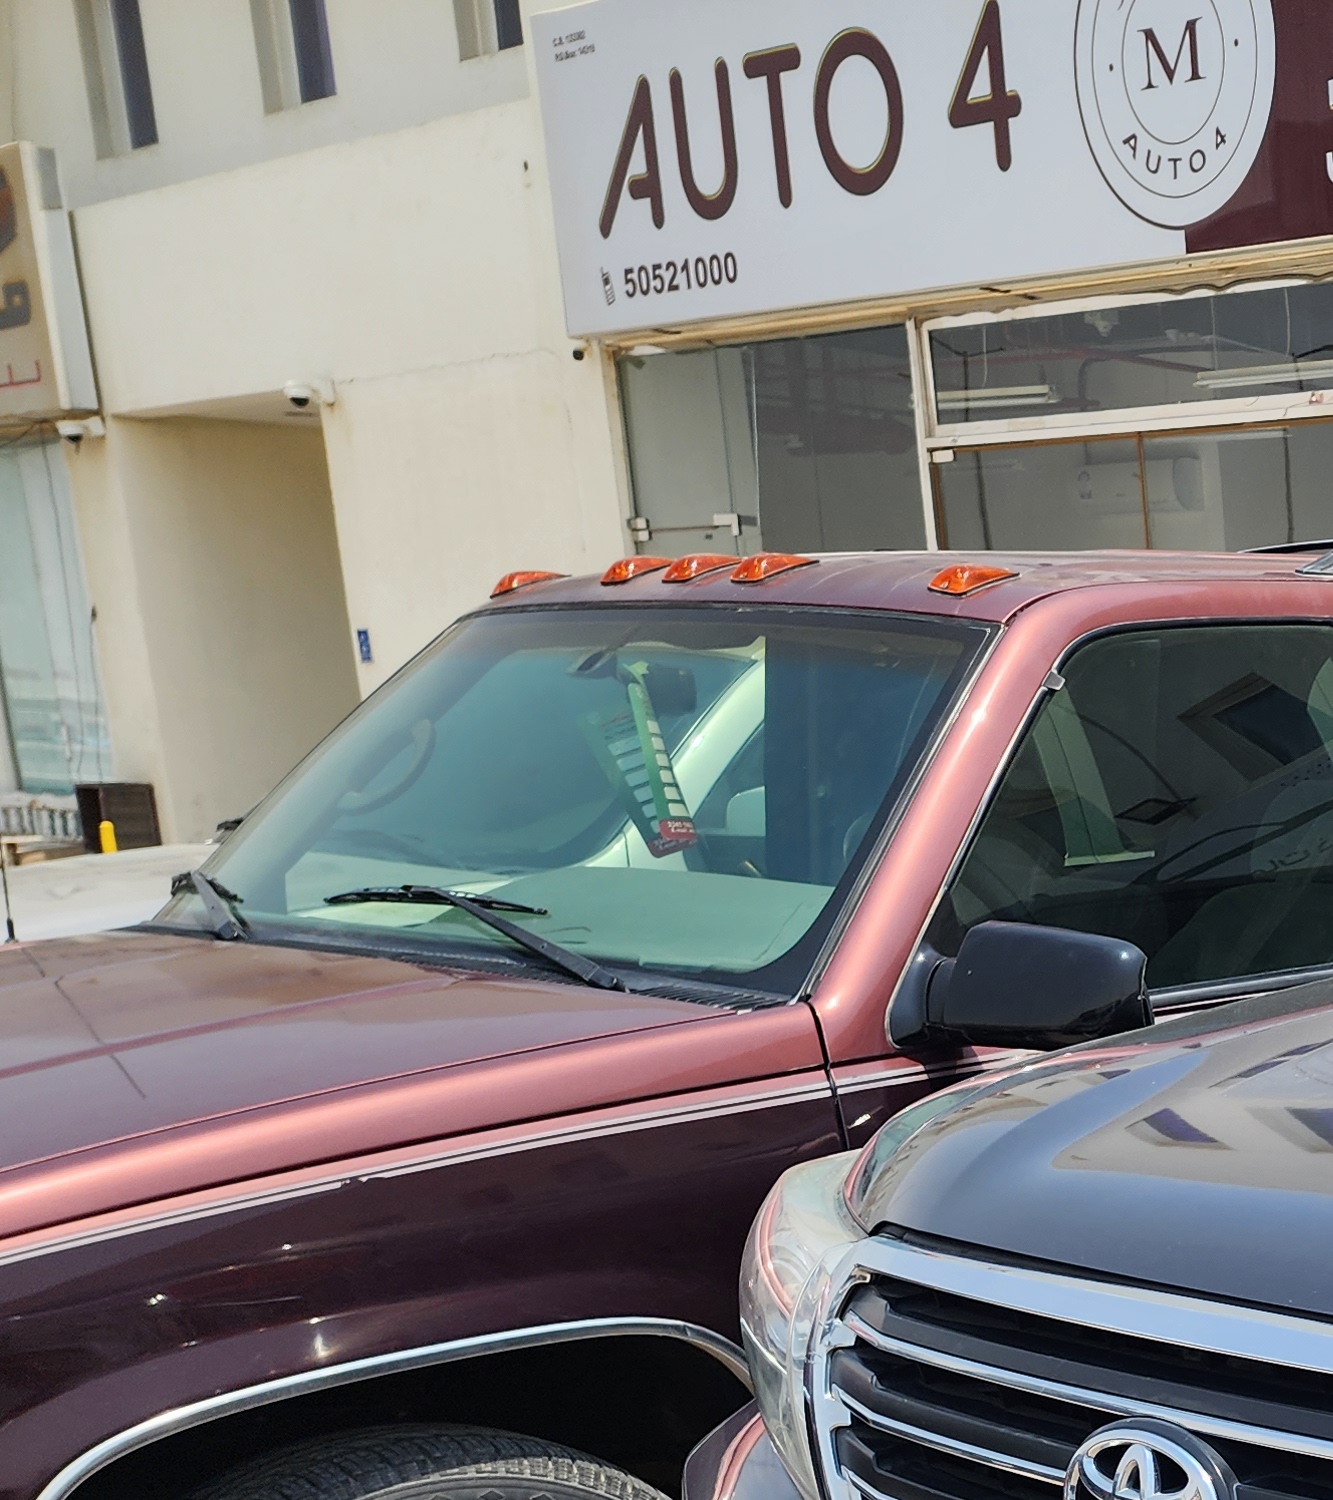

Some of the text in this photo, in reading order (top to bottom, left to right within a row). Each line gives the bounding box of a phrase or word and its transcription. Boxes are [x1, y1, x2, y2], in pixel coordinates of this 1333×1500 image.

[1137, 16, 1207, 92] M
[599, 0, 1023, 240] AUTO 4
[1122, 125, 1227, 180] AUTO 4
[623, 251, 739, 299] 50521000
